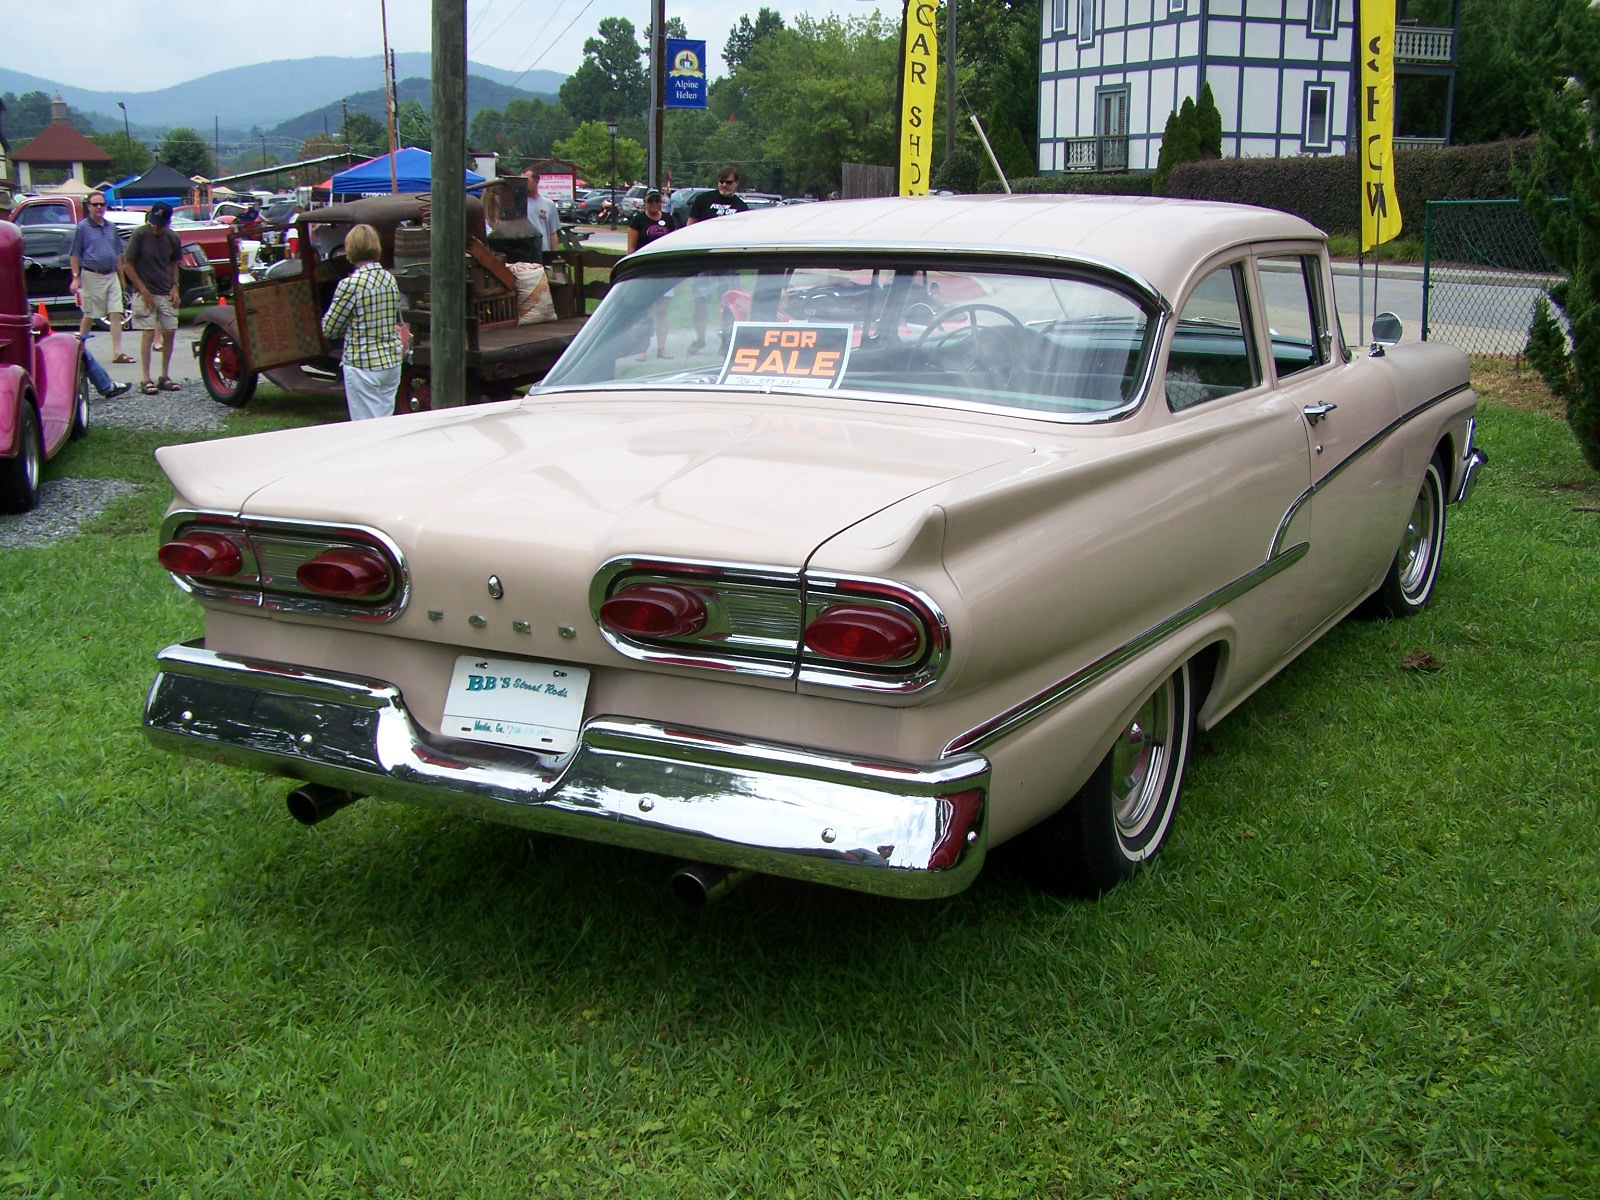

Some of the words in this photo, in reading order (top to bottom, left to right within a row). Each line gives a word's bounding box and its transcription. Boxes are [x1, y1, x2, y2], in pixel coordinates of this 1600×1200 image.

[911, 4, 935, 85] CAR
[674, 80, 699, 90] Alpine
[676, 90, 698, 99] Helen
[909, 105, 923, 196] SHO
[763, 330, 817, 348] FOR
[730, 348, 841, 376] SALE
[512, 678, 543, 693] Street
[544, 683, 568, 698] Rods
